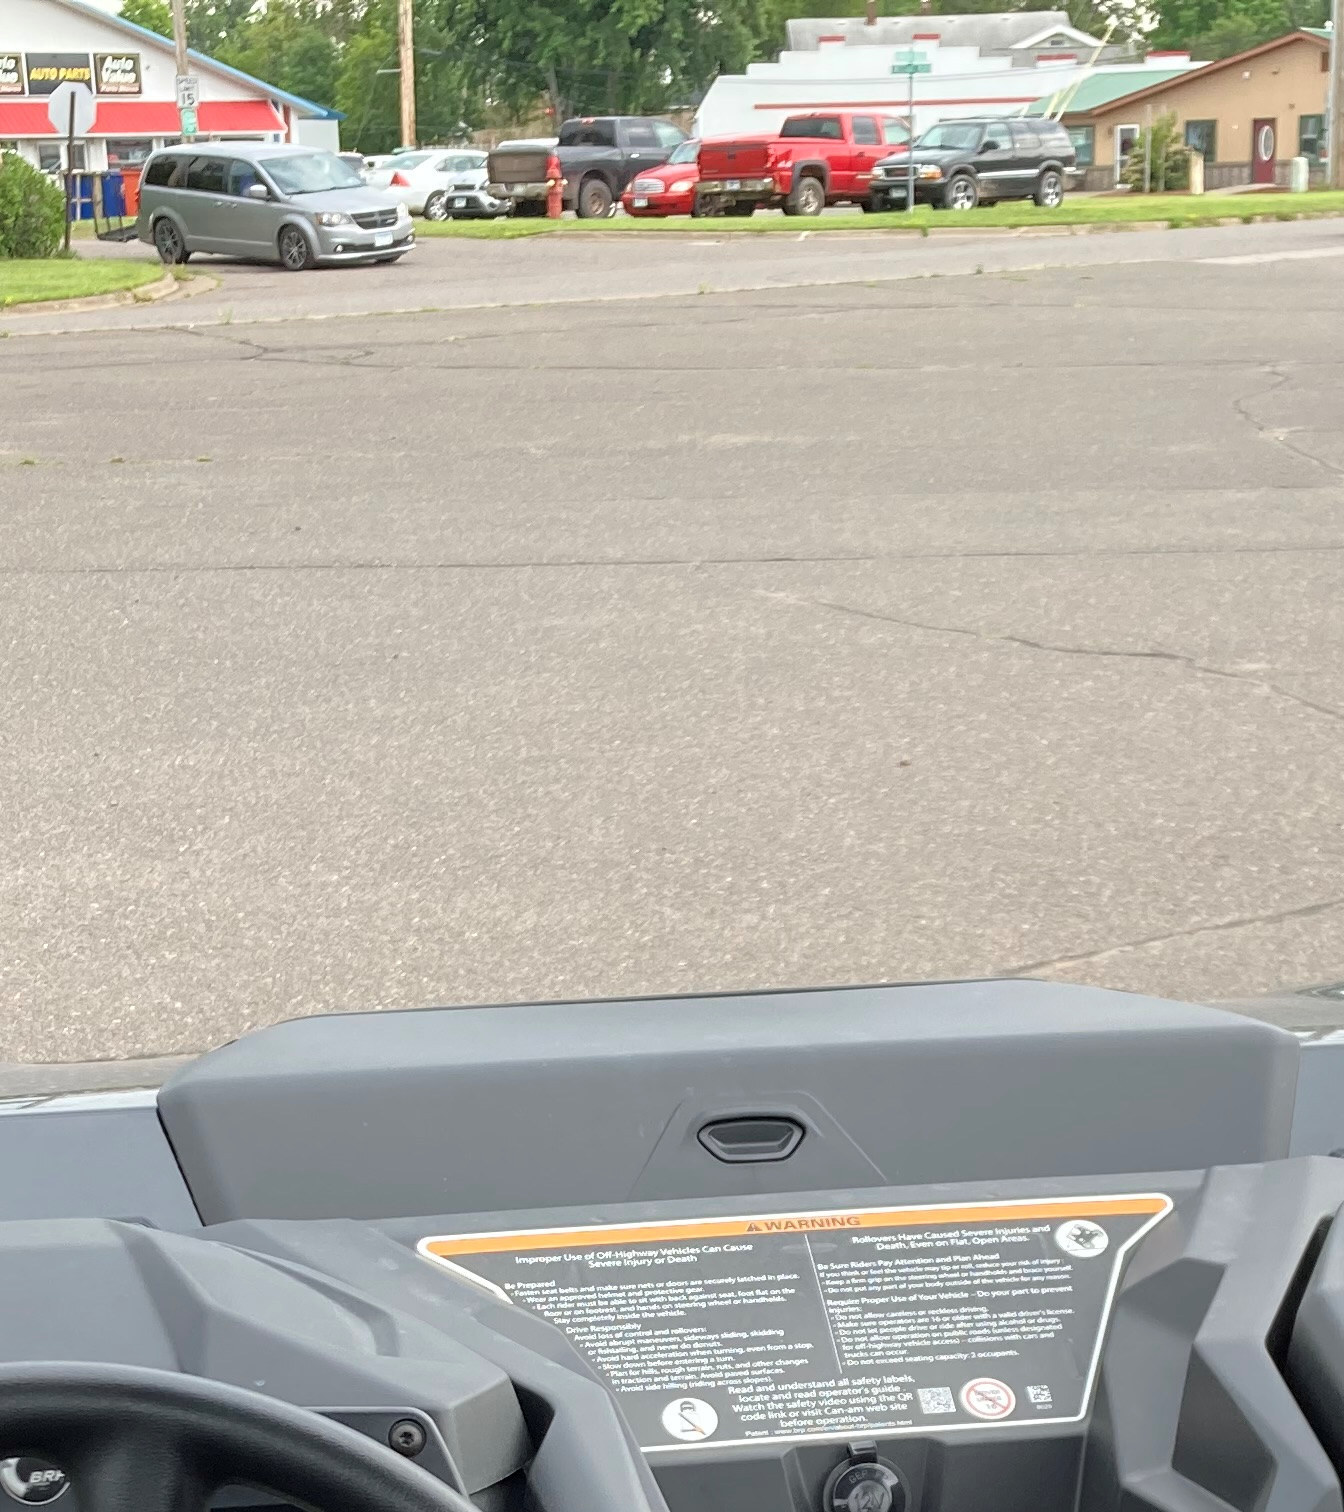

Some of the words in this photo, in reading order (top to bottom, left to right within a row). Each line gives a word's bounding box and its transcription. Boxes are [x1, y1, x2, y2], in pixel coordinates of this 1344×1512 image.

[103, 56, 134, 71] Auto
[30, 68, 58, 80] AUTO
[59, 68, 91, 80] PARTS
[182, 93, 195, 106] 15
[764, 1216, 861, 1231] WARNING
